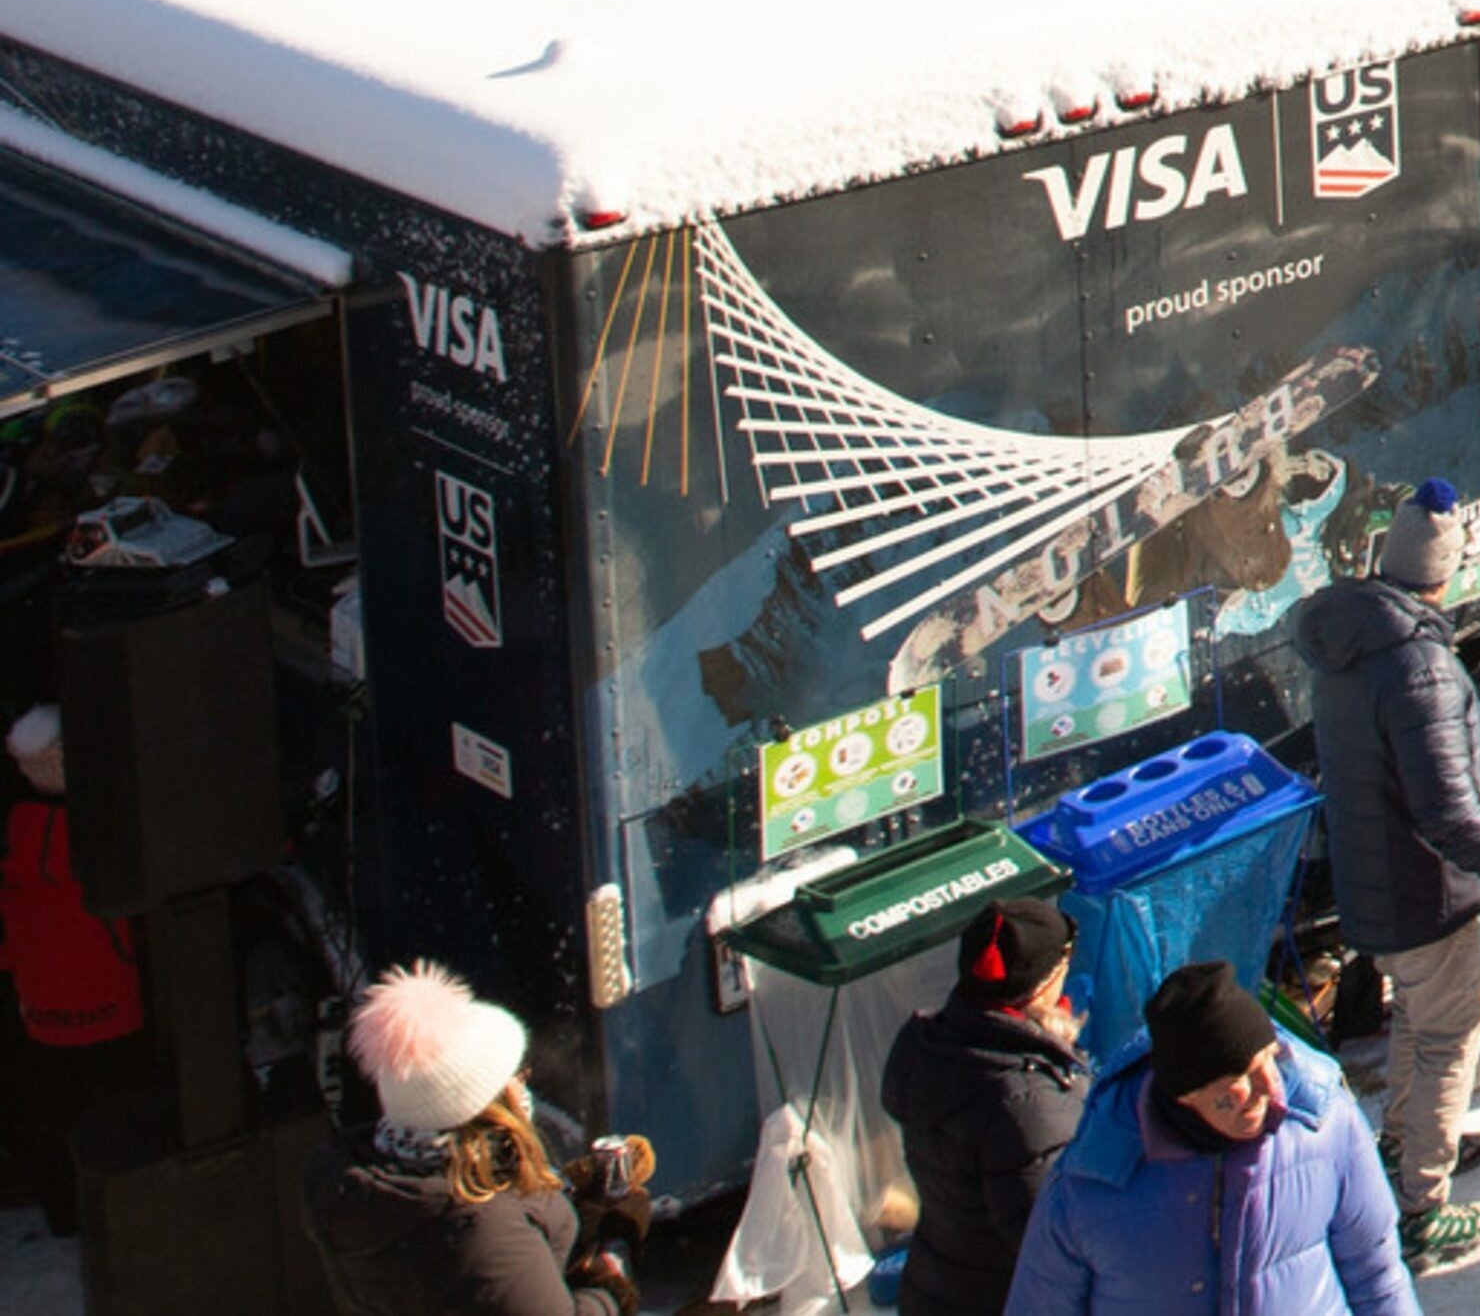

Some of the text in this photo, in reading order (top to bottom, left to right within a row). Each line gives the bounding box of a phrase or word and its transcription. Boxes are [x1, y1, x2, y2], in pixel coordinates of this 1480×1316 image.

[1313, 67, 1394, 116] US
[1021, 122, 1249, 242] VISA
[396, 270, 508, 384] VISA
[1124, 252, 1325, 335] proud sponsor
[440, 475, 492, 550] US
[789, 697, 913, 752] COMPOST
[1126, 786, 1223, 838] BOTTLES
[1132, 789, 1249, 849] CANS ONLY
[847, 857, 1020, 941] COMPOSTABLES
